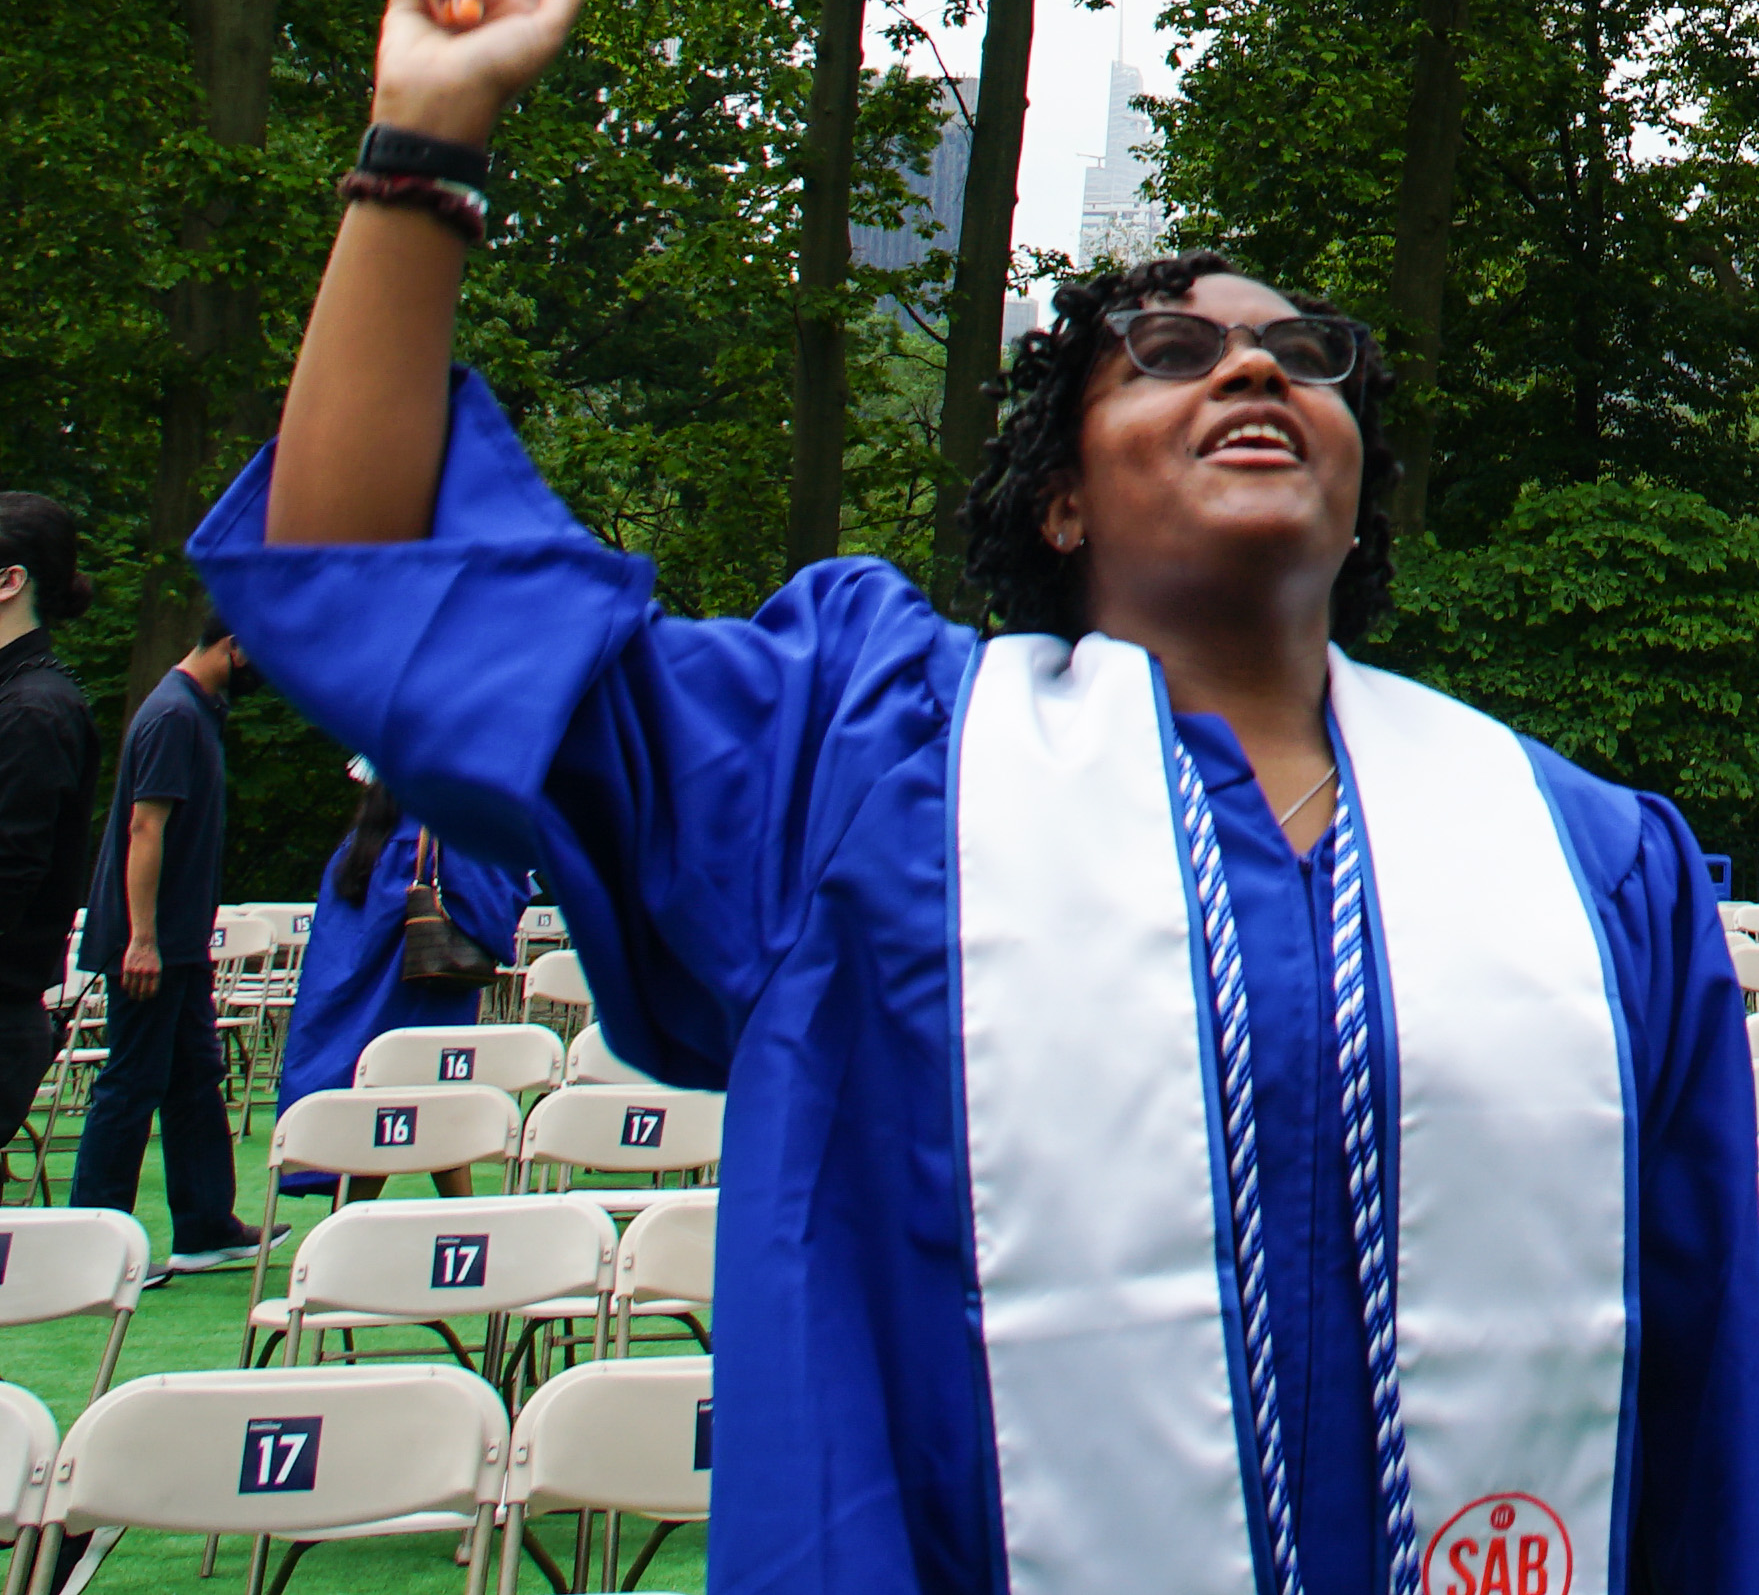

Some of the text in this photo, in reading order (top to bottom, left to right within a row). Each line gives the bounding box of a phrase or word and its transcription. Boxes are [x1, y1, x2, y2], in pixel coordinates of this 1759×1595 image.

[296, 917, 310, 931] 15
[444, 1054, 468, 1079] 16
[382, 1114, 409, 1144] 16
[629, 1115, 659, 1144] 17
[442, 1245, 480, 1284] 17
[257, 1432, 309, 1485] 17
[1446, 1534, 1549, 1595] SAB
